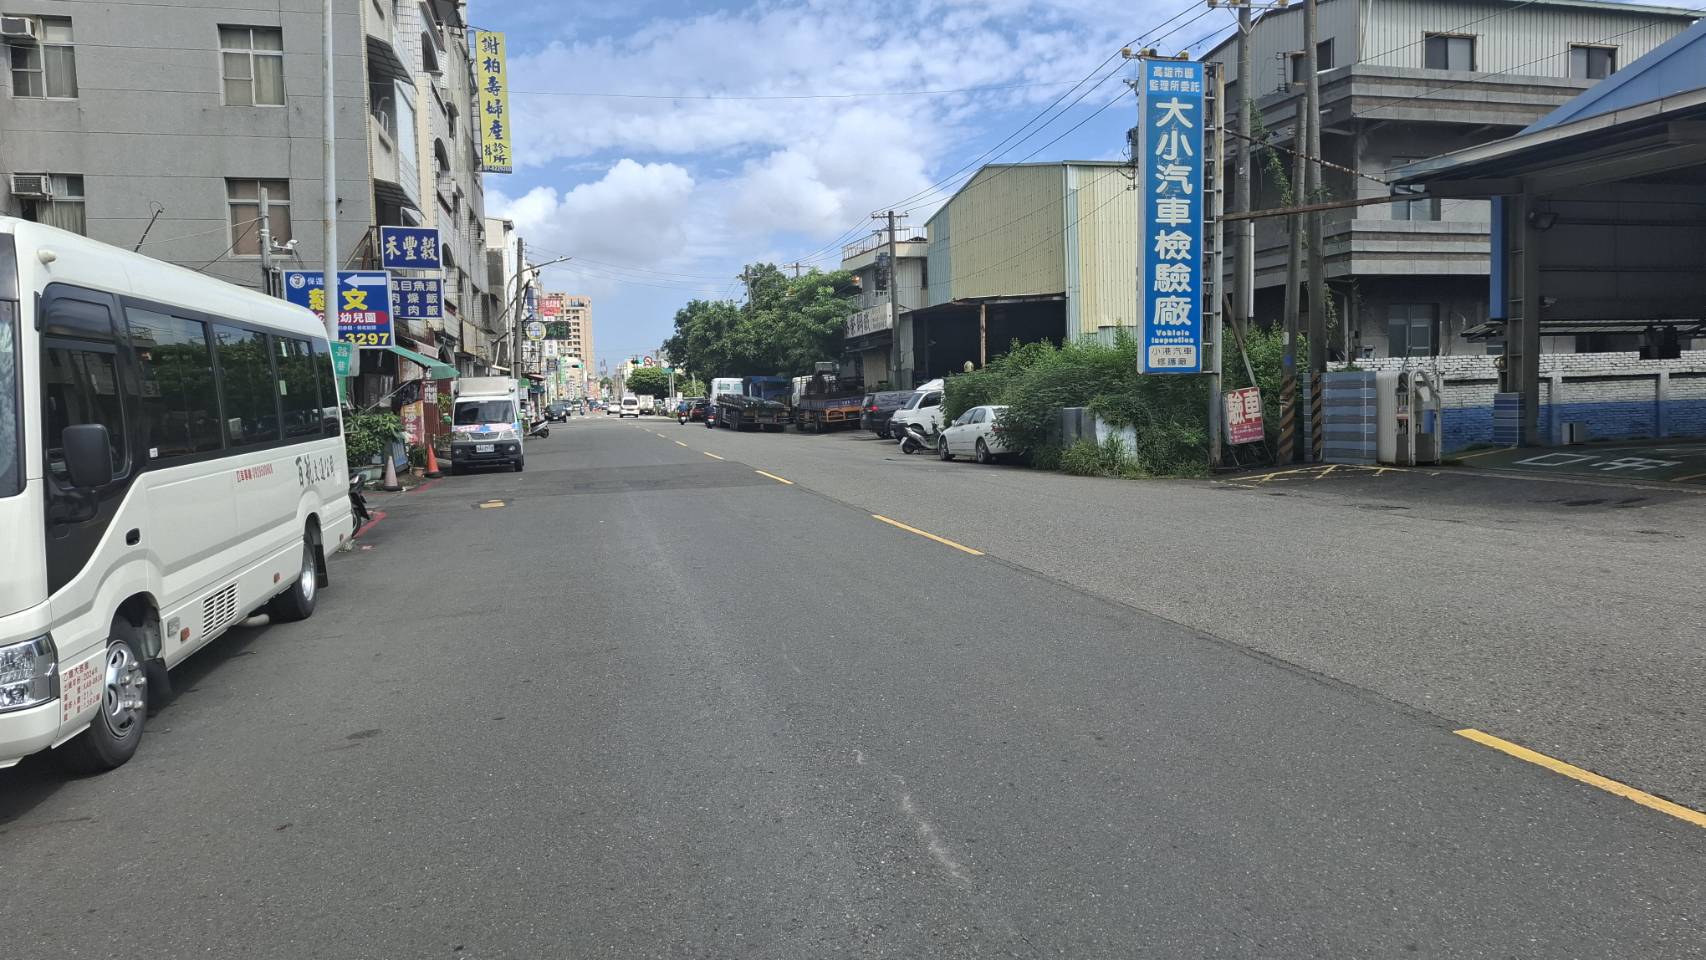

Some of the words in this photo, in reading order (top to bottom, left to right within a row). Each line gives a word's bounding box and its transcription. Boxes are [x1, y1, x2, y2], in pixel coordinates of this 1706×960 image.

[1149, 79, 1201, 93] 監理所委託
[1154, 97, 1194, 326] 大小汽車檢驗廠
[338, 312, 376, 324] 幼兒園
[1155, 328, 1190, 337] Vehicle
[1151, 337, 1194, 345] Inspection
[1152, 347, 1192, 356] 小港汽車
[1227, 390, 1262, 425] 驗車
